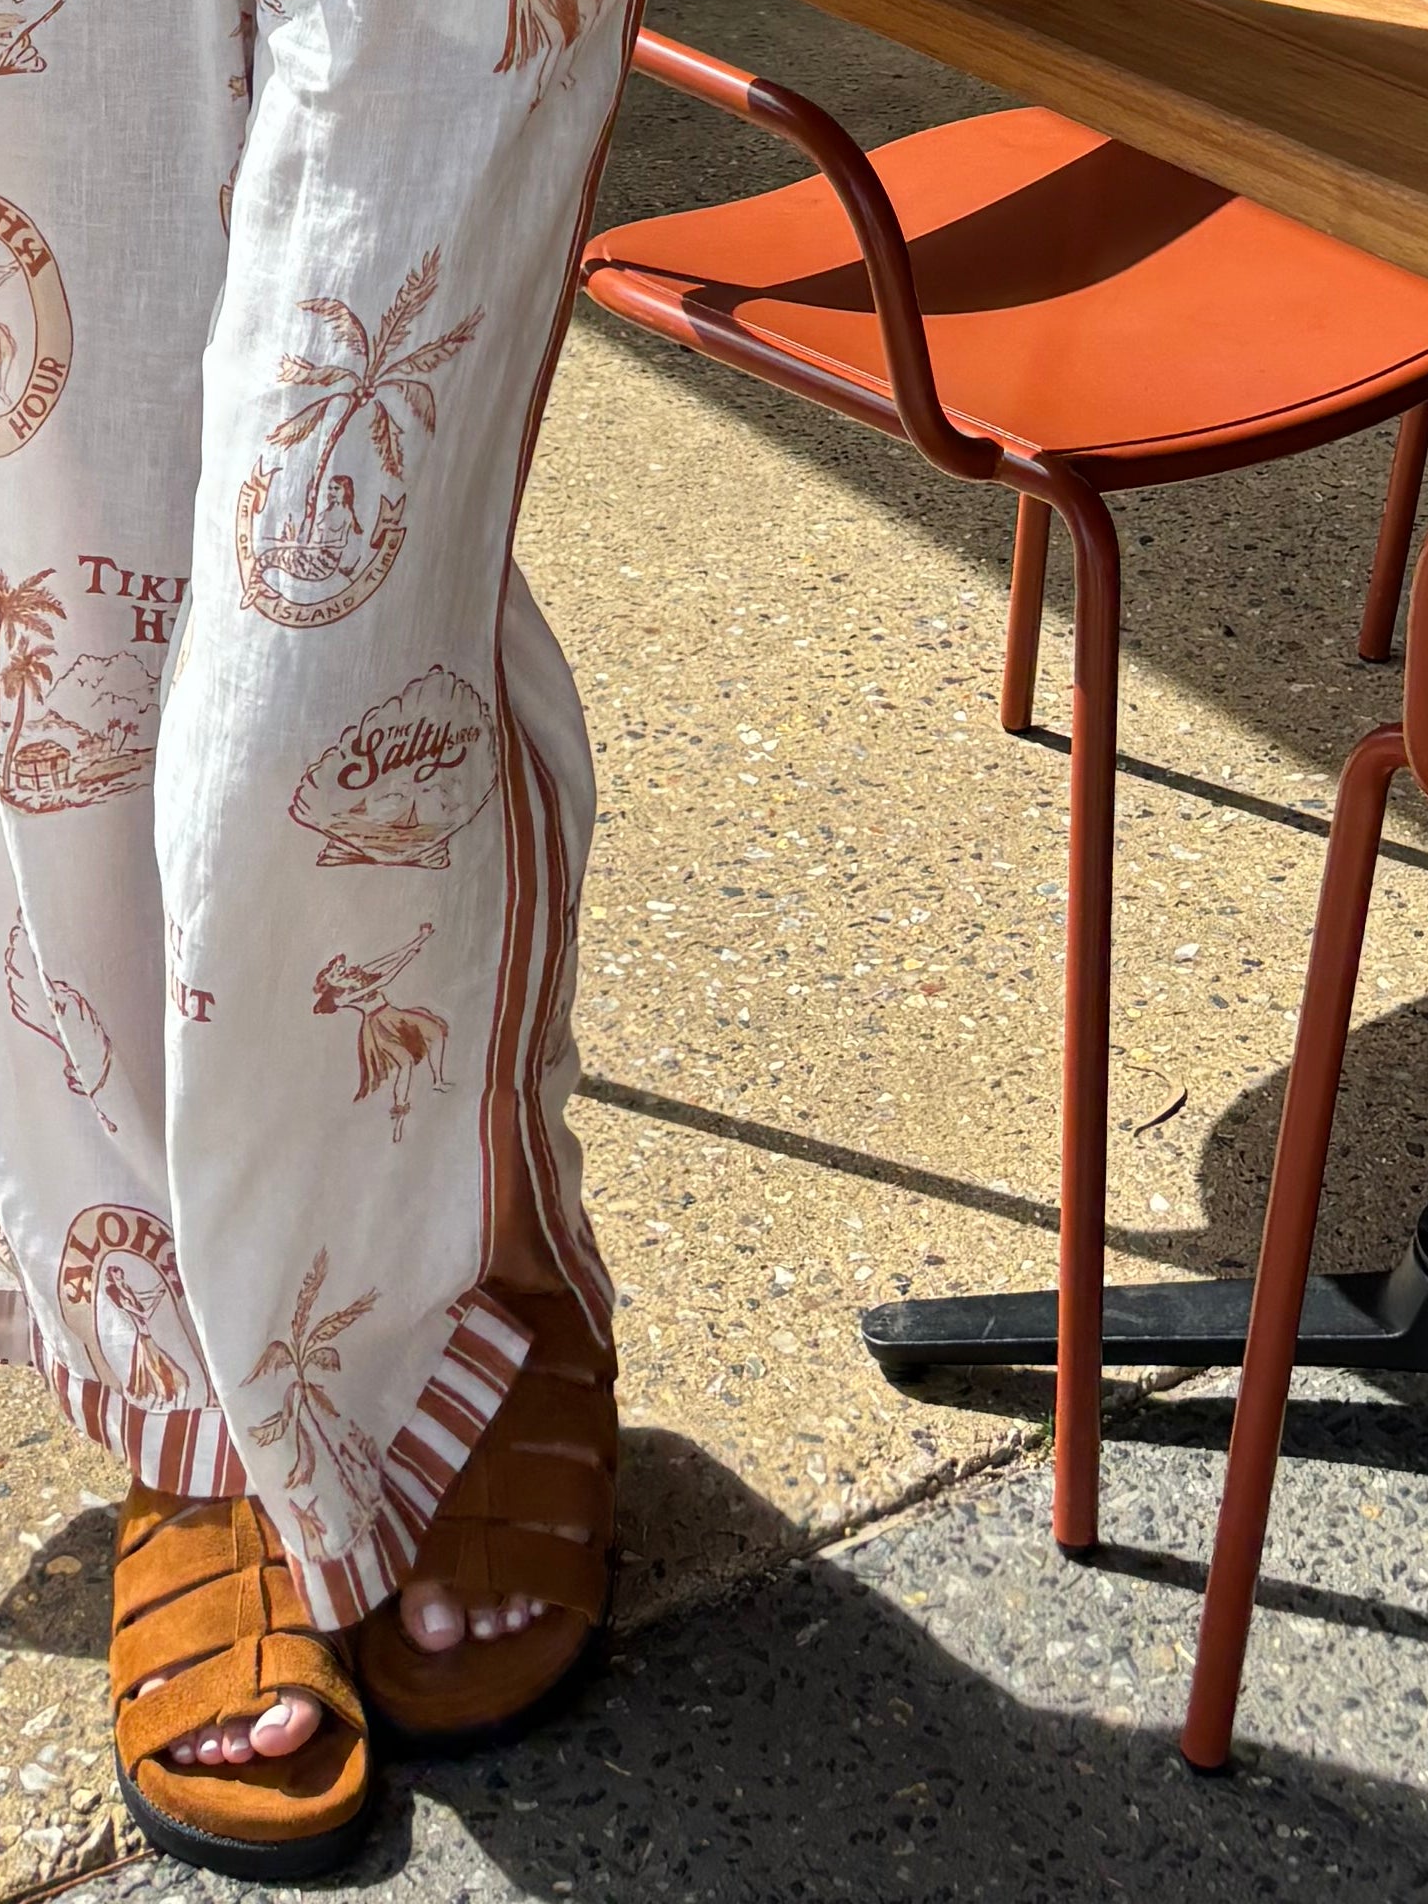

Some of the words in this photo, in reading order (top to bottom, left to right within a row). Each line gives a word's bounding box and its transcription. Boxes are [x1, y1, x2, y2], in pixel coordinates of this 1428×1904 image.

[8, 355, 67, 440] HOUR
[78, 555, 191, 604] TIKI
[273, 596, 356, 623] ISLAND
[337, 716, 467, 791] Salty
